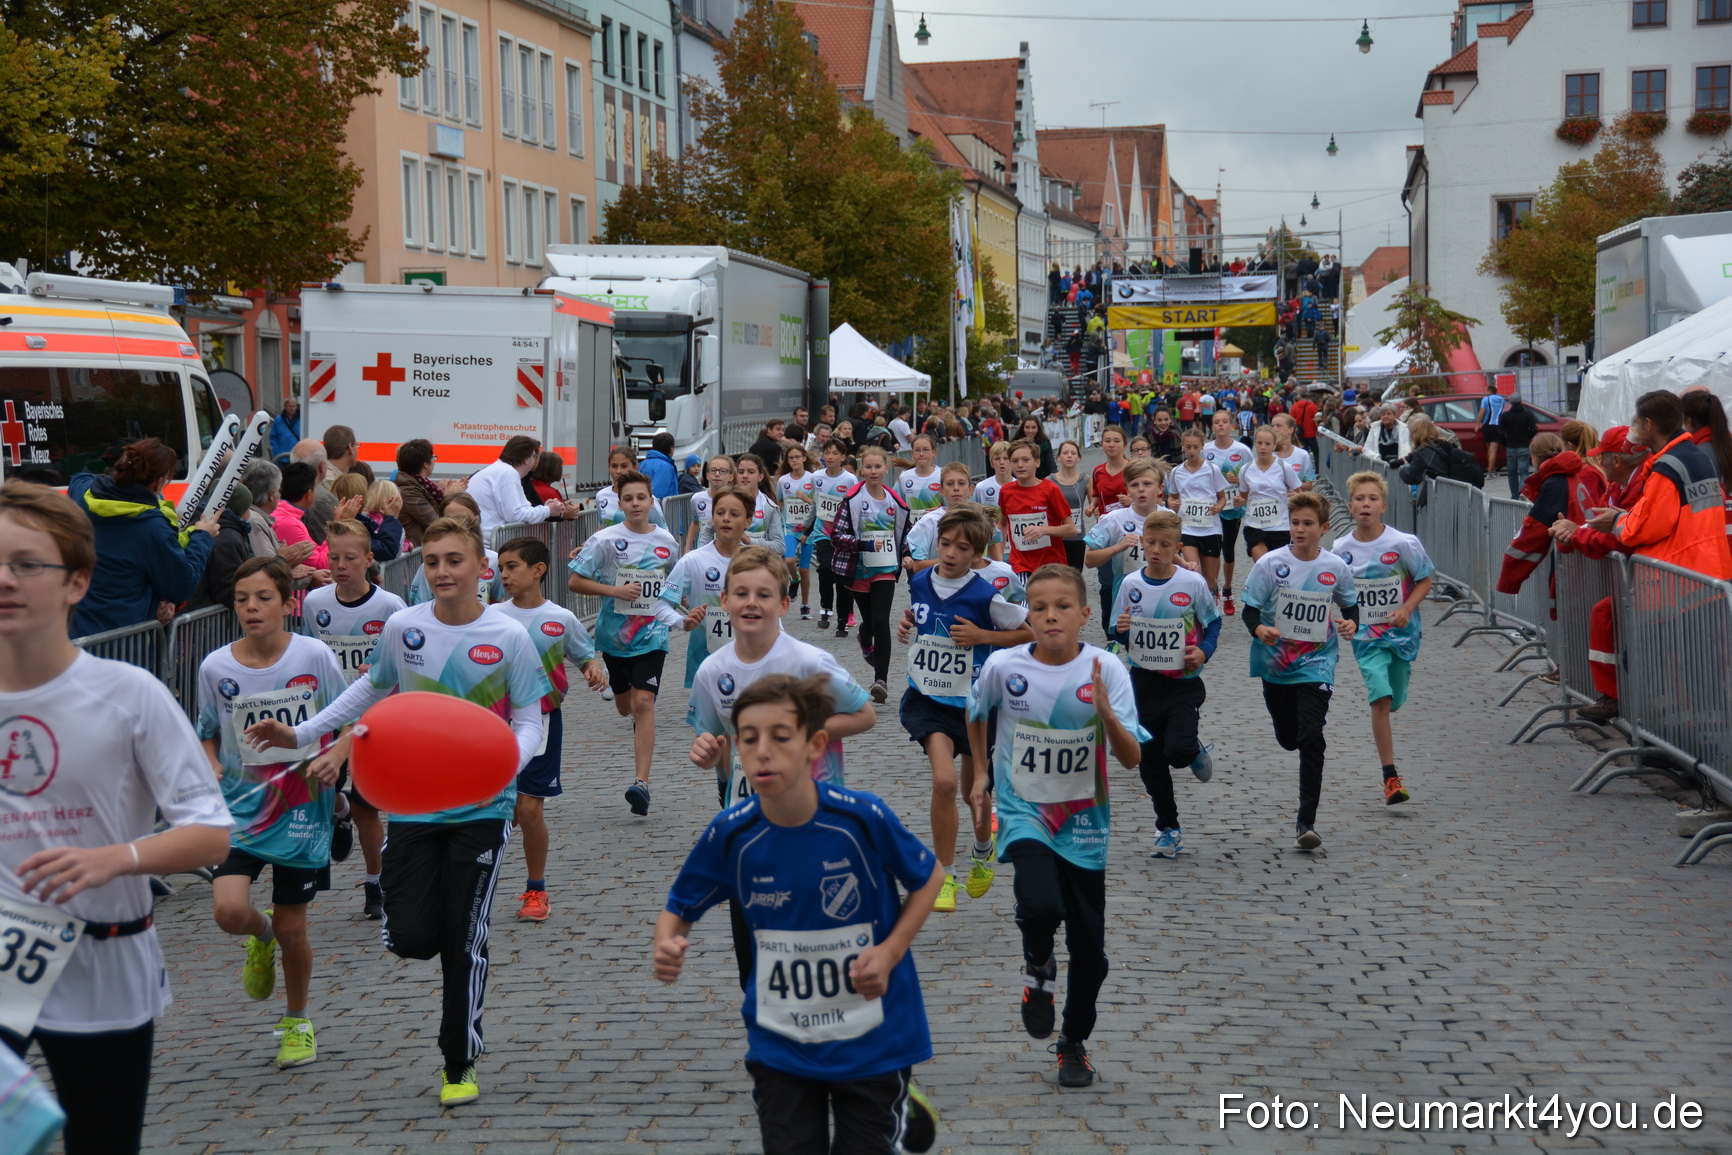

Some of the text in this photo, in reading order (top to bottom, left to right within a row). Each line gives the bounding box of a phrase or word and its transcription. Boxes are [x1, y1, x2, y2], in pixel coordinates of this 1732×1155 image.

[576, 294, 649, 311] OCK
[1162, 309, 1220, 324] START
[413, 353, 493, 367] Bayerisches
[413, 369, 451, 382] Rotes
[834, 377, 887, 389] Laufsport
[412, 386, 451, 399] Kreuz
[24, 401, 65, 423] Bayerisches
[28, 423, 48, 442] Rotes
[453, 422, 537, 432] Katastrophenschutz
[460, 432, 497, 440] Freistaat
[30, 446, 51, 464] Kreuz
[237, 442, 258, 475] BMW
[788, 504, 810, 515] 4046
[821, 500, 839, 513] 401
[1185, 505, 1210, 517] 4012
[1252, 504, 1278, 518] 4034
[1014, 521, 1044, 537] 40
[624, 581, 661, 598] 08
[1280, 592, 1325, 603] PARTL Neumarkt
[1356, 588, 1399, 608] 4032
[630, 601, 650, 610] Lukas
[1282, 601, 1327, 623] 4000
[911, 602, 930, 624] 13
[1367, 610, 1388, 619] Kilian
[544, 624, 563, 633] Hervis
[712, 620, 732, 638] 41
[1293, 625, 1312, 635] Elias
[1134, 630, 1180, 650] 4042
[333, 648, 374, 670] 10
[404, 651, 425, 661] PARTL
[473, 648, 499, 660] Hervis
[1140, 654, 1174, 663] Jonathan
[913, 648, 967, 675] 4025
[923, 677, 952, 689] Fabian
[233, 701, 259, 710] PARTL
[260, 694, 300, 707] Neumarkt
[1008, 699, 1029, 707] PARTL
[1016, 731, 1084, 745] PARTL Neumarkt
[1020, 746, 1089, 774] 4102
[24, 810, 48, 822] MIT
[54, 806, 94, 820] HERZ
[292, 809, 308, 821] 16.
[1073, 814, 1092, 827] 16.
[1072, 836, 1107, 845] Stadtlauf
[759, 940, 852, 953] PARTL Neumarkt
[0, 926, 57, 985] 35
[790, 1008, 845, 1028] Yannik
